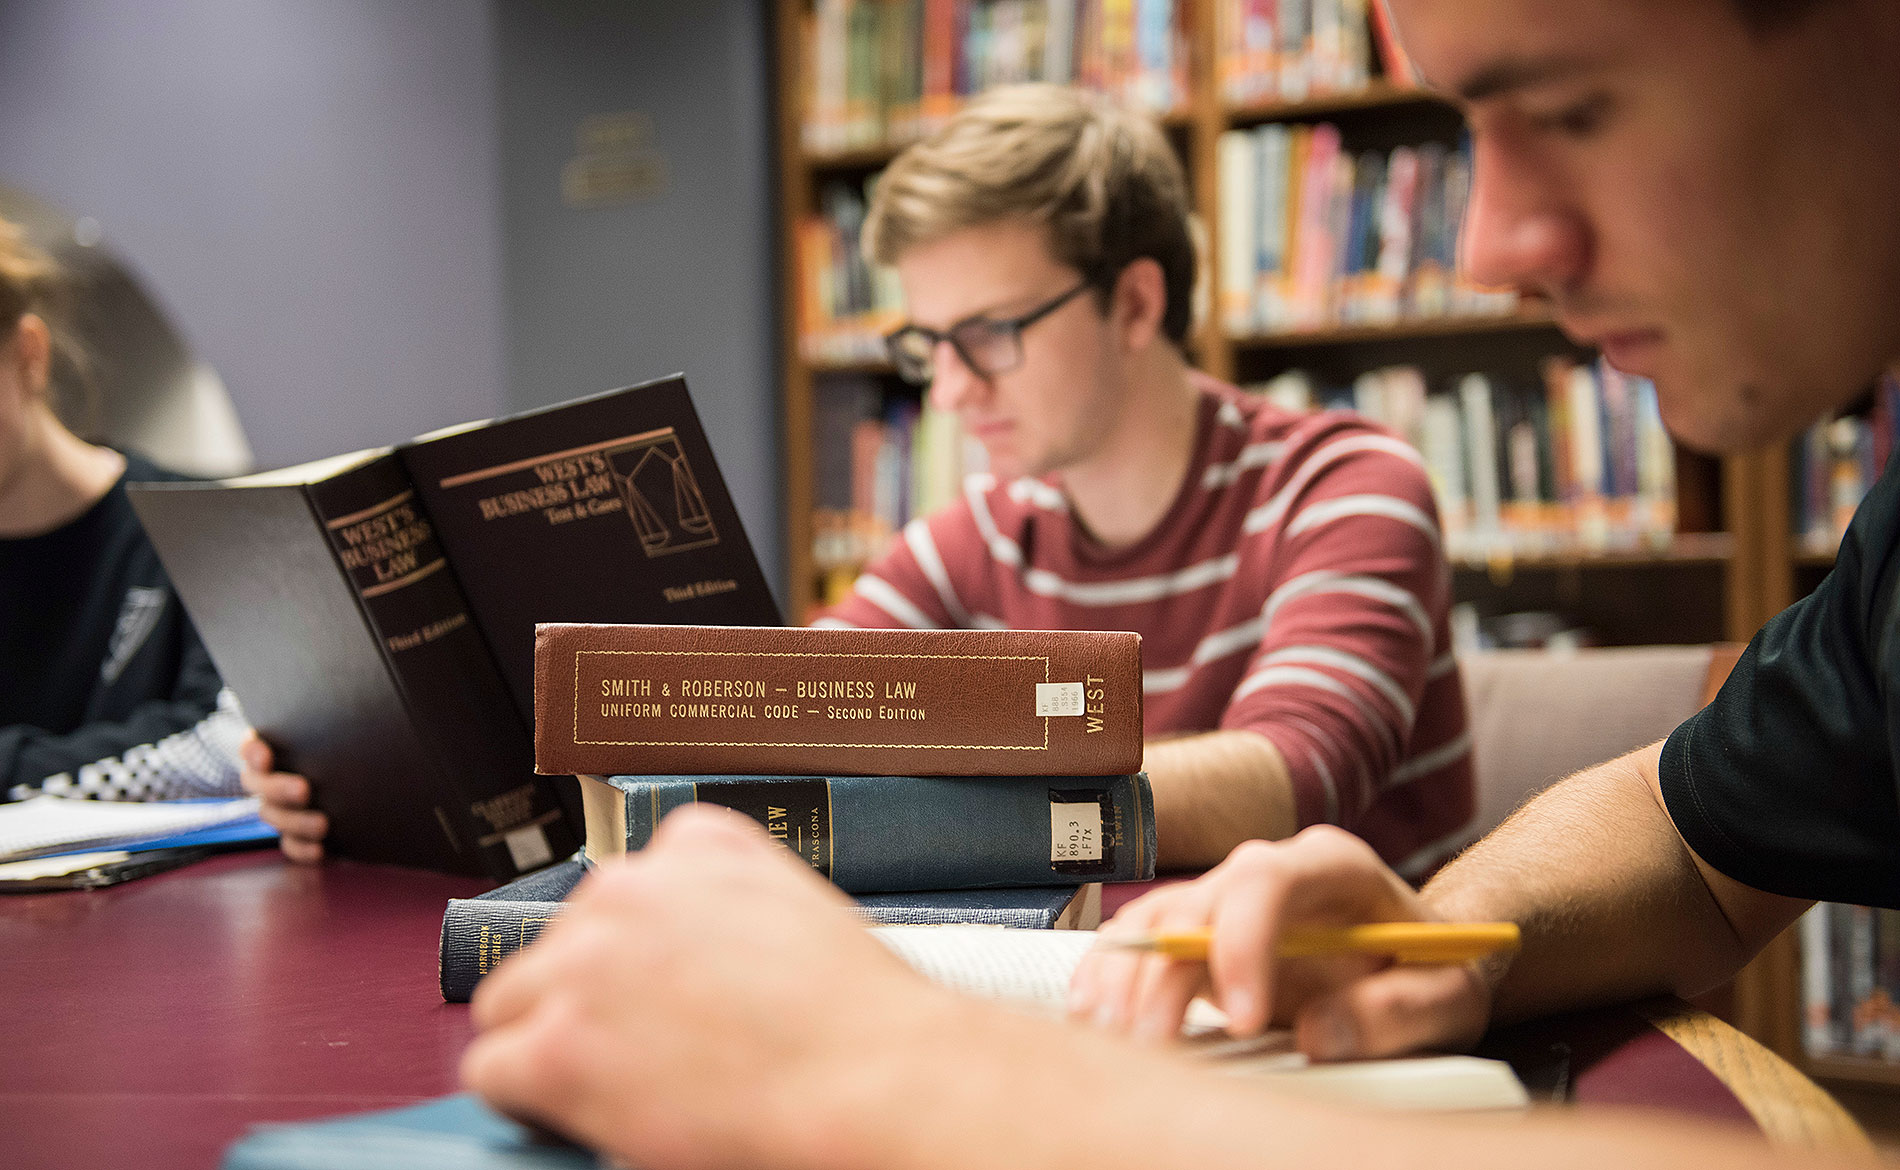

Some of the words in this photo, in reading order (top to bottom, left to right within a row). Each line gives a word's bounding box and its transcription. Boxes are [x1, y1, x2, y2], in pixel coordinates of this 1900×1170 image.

[479, 483, 568, 520] BUSINESS
[569, 472, 611, 499] LAW
[601, 679, 651, 697] SMITH
[661, 682, 671, 697] &
[681, 680, 766, 698] ROBERSON
[797, 681, 875, 699] BUSINESS
[885, 682, 917, 699] LAW
[1070, 691, 1079, 711] 1966
[1086, 673, 1105, 734] WEST
[600, 703, 661, 718] UNIFORM
[669, 703, 756, 719] COMMERCIAL
[764, 704, 799, 719] CODE
[810, 806, 821, 868] FRASCONA
[1068, 820, 1080, 857] 890.3
[1114, 805, 1124, 847] IRWIN
[1056, 843, 1067, 858] KF
[479, 925, 490, 975] HORNBOOK
[492, 933, 502, 966] SERIES
